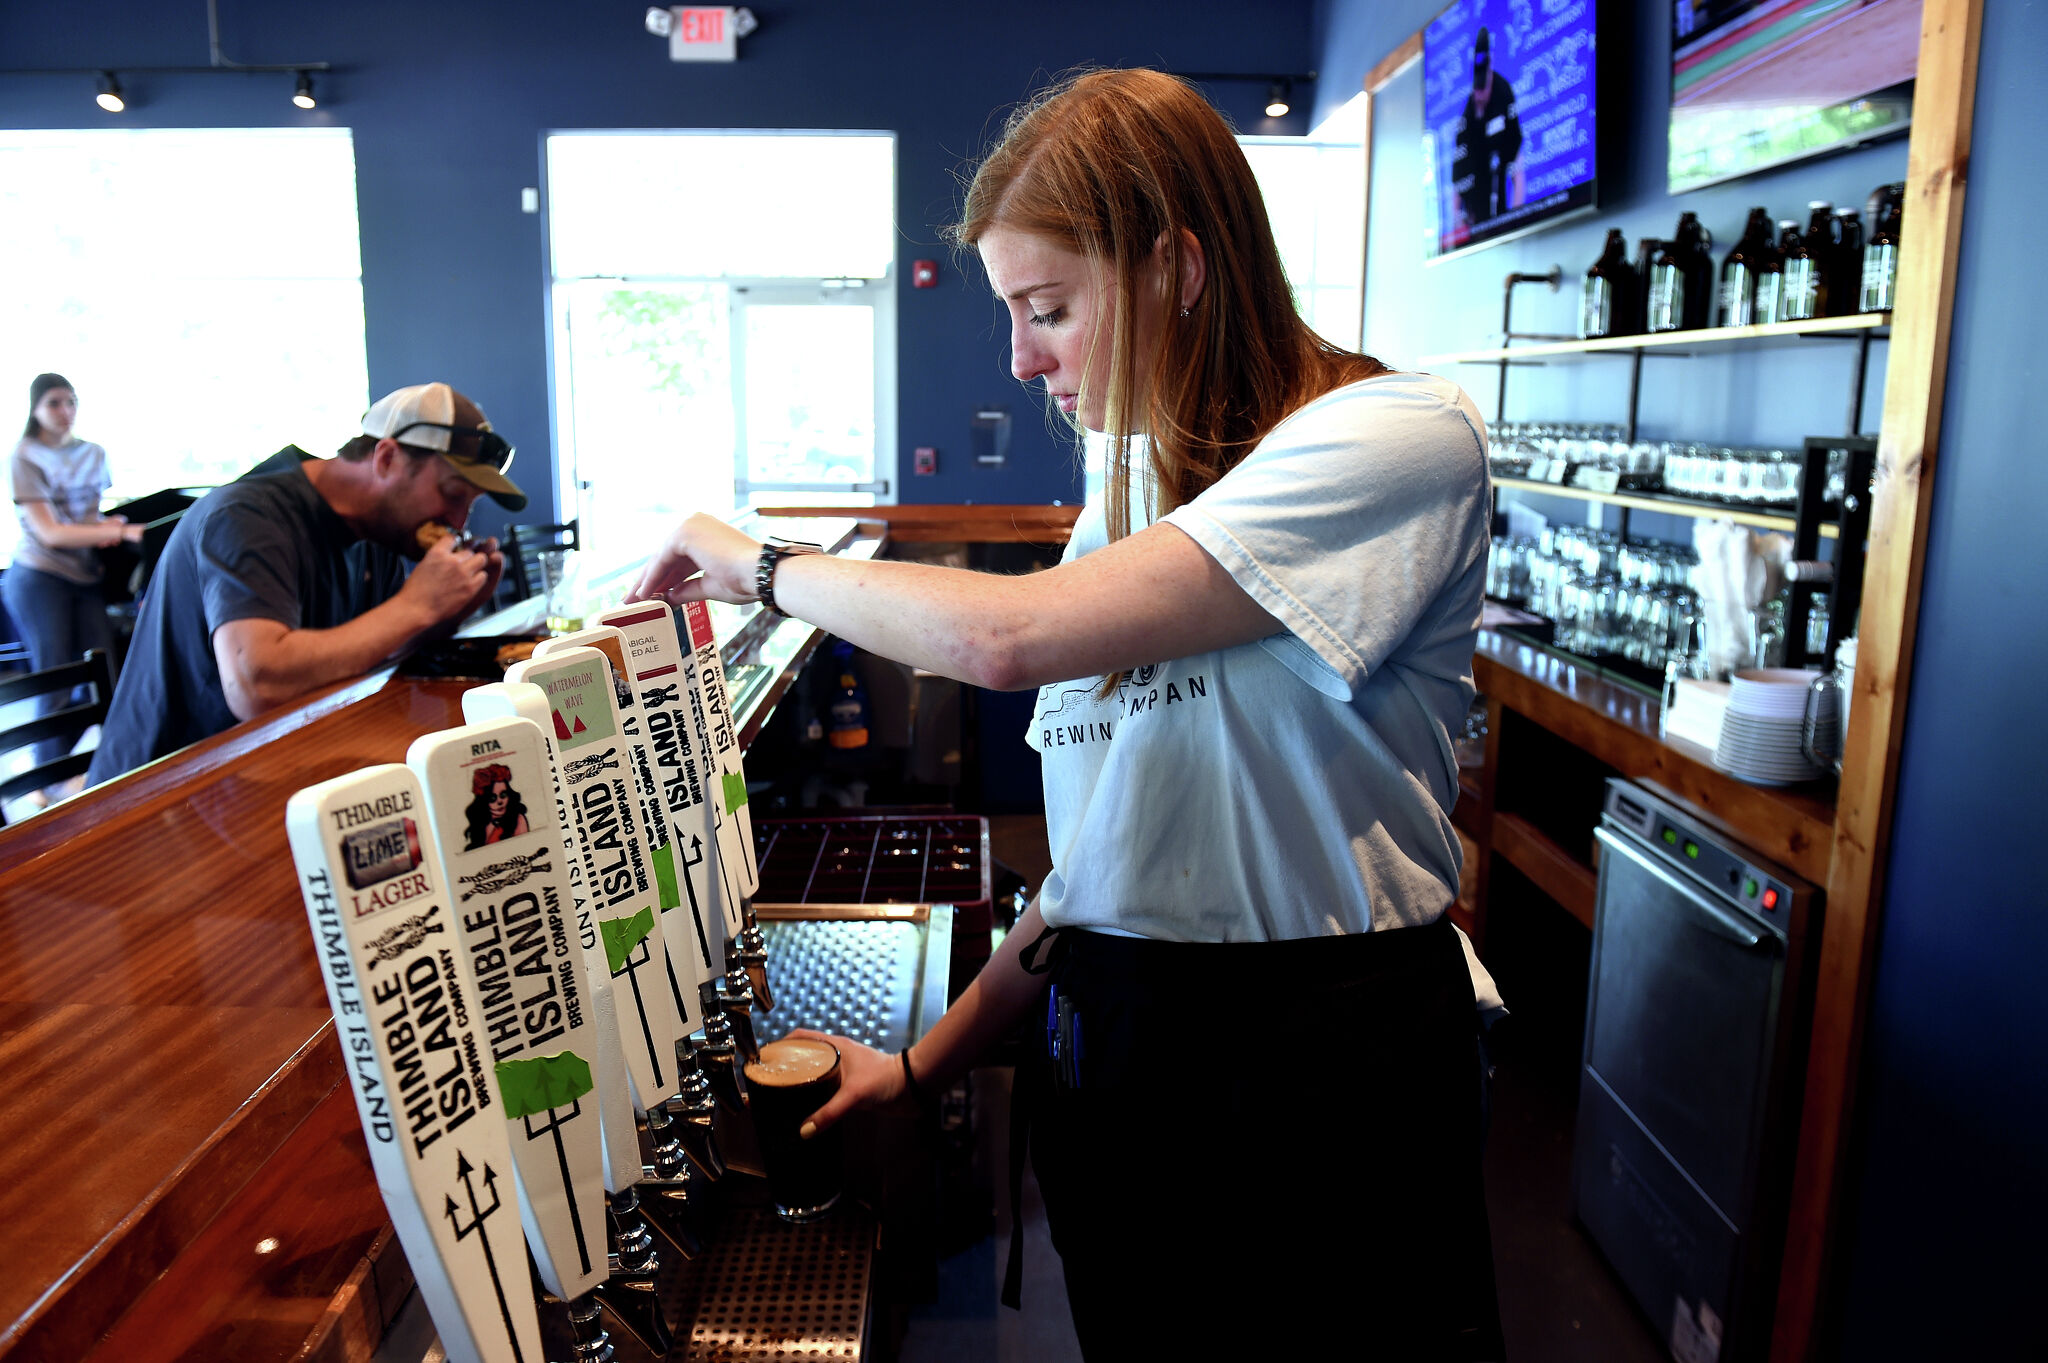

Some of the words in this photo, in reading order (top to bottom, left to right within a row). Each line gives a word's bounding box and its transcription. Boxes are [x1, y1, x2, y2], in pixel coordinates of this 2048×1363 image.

[682, 9, 725, 43] EXIT
[632, 649, 643, 658] ED
[645, 644, 660, 654] ALE
[547, 672, 593, 695] WATERMELON
[564, 693, 584, 709] WAVE
[702, 668, 730, 755] ISLAND
[1043, 721, 1113, 748] REWIN
[1129, 676, 1207, 717] MPAN
[471, 739, 502, 756] RITA
[672, 709, 692, 757] COMPANY
[724, 708, 736, 747] BREWING
[647, 711, 691, 813] ISLAND
[684, 758, 704, 805] BREWING
[331, 791, 413, 830] THIMBLE
[612, 778, 635, 836] COMPANY
[353, 831, 405, 869] LIME
[582, 782, 635, 907] ISLAND
[627, 837, 649, 893] BREWING
[351, 873, 430, 918] LAGER
[542, 886, 569, 958] COMPANY
[438, 948, 469, 1028] COMPANY
[463, 905, 525, 1062] THIMBLE
[502, 891, 566, 1048] ISLAND
[559, 959, 584, 1030] BREWING
[307, 868, 363, 1016] THIMBLE
[347, 1025, 395, 1144] ISLAND
[372, 972, 442, 1160] THIMBLE
[405, 955, 476, 1134] ISLAND
[462, 1032, 491, 1110] BREWING
